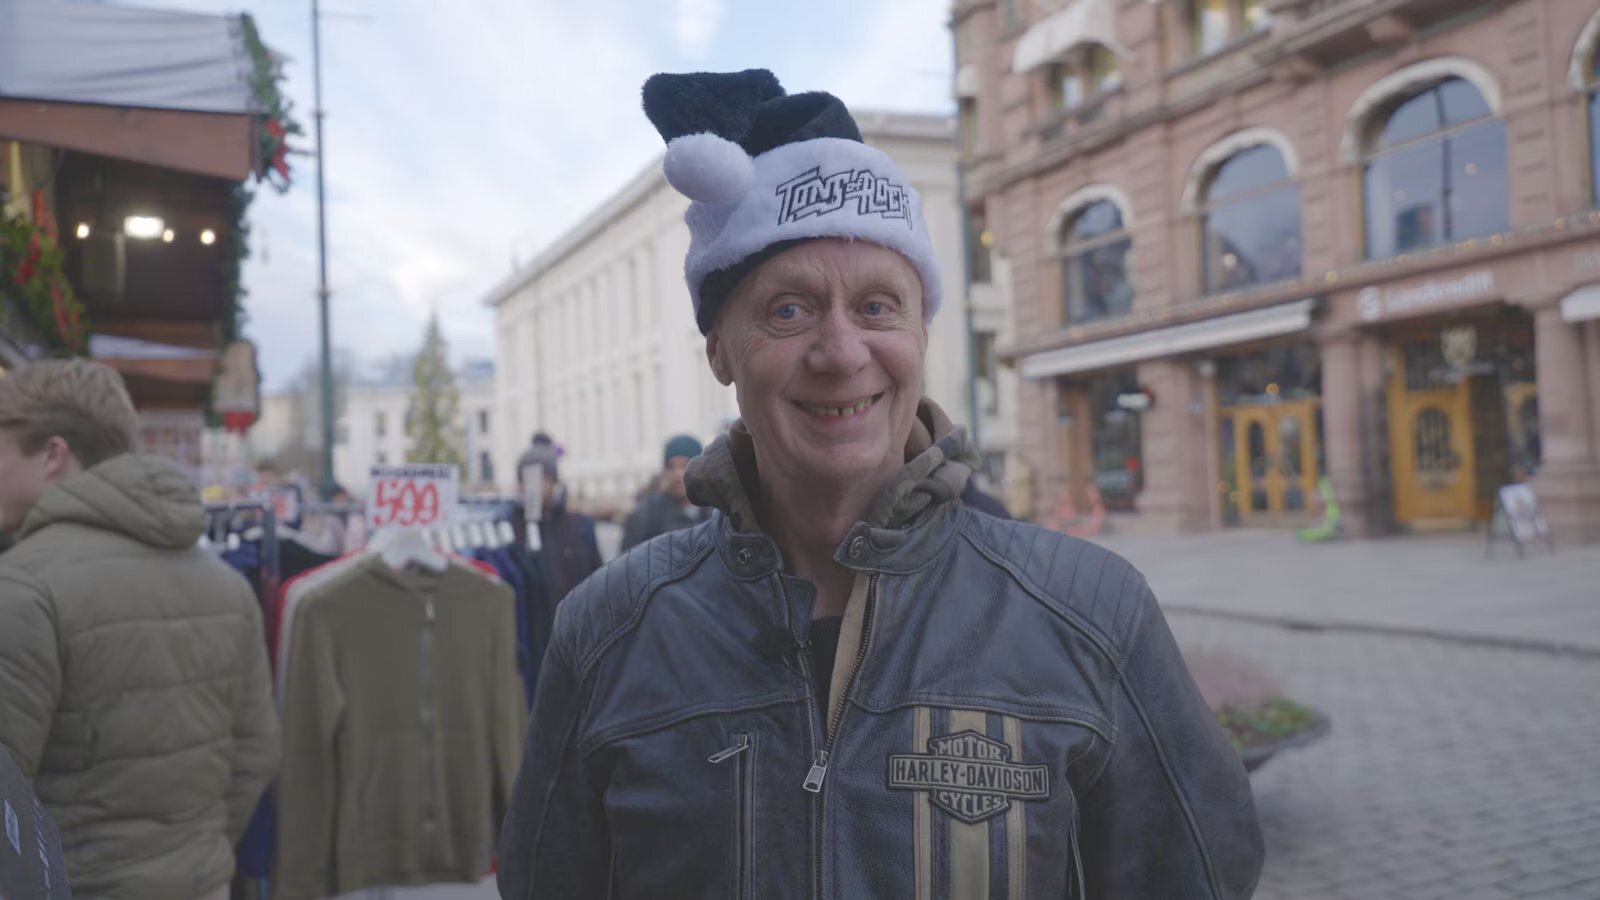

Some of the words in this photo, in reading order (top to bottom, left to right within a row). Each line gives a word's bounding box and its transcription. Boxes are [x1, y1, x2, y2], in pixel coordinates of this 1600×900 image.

[775, 165, 854, 226] TONS
[373, 480, 438, 526] 599
[938, 736, 1001, 760] MOTOR
[895, 760, 1043, 793] HARLEY-DAVIDSON
[938, 792, 1001, 816] CYCLES
